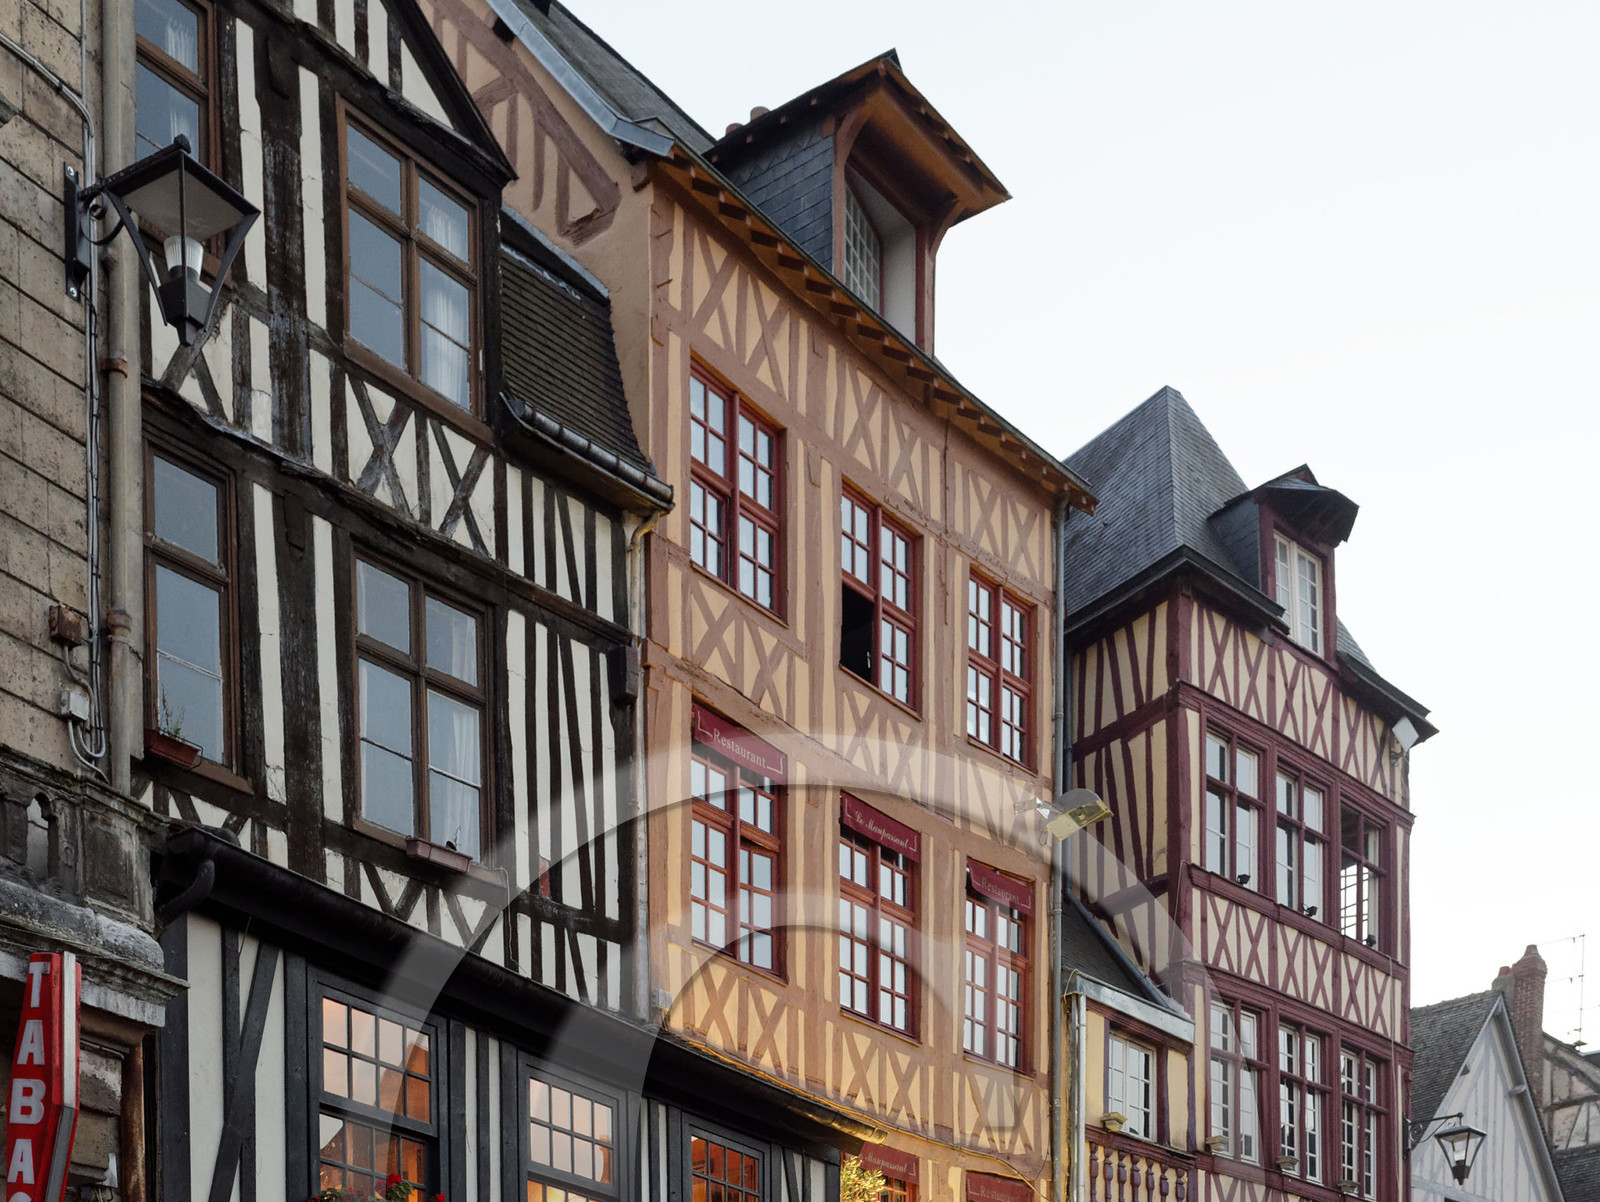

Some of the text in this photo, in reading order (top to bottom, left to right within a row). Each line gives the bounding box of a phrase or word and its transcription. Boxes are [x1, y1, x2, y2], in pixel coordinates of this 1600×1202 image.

[713, 728, 766, 768] Restaurant
[854, 811, 909, 848] Le Maupassant
[981, 876, 1019, 905] Restaurant
